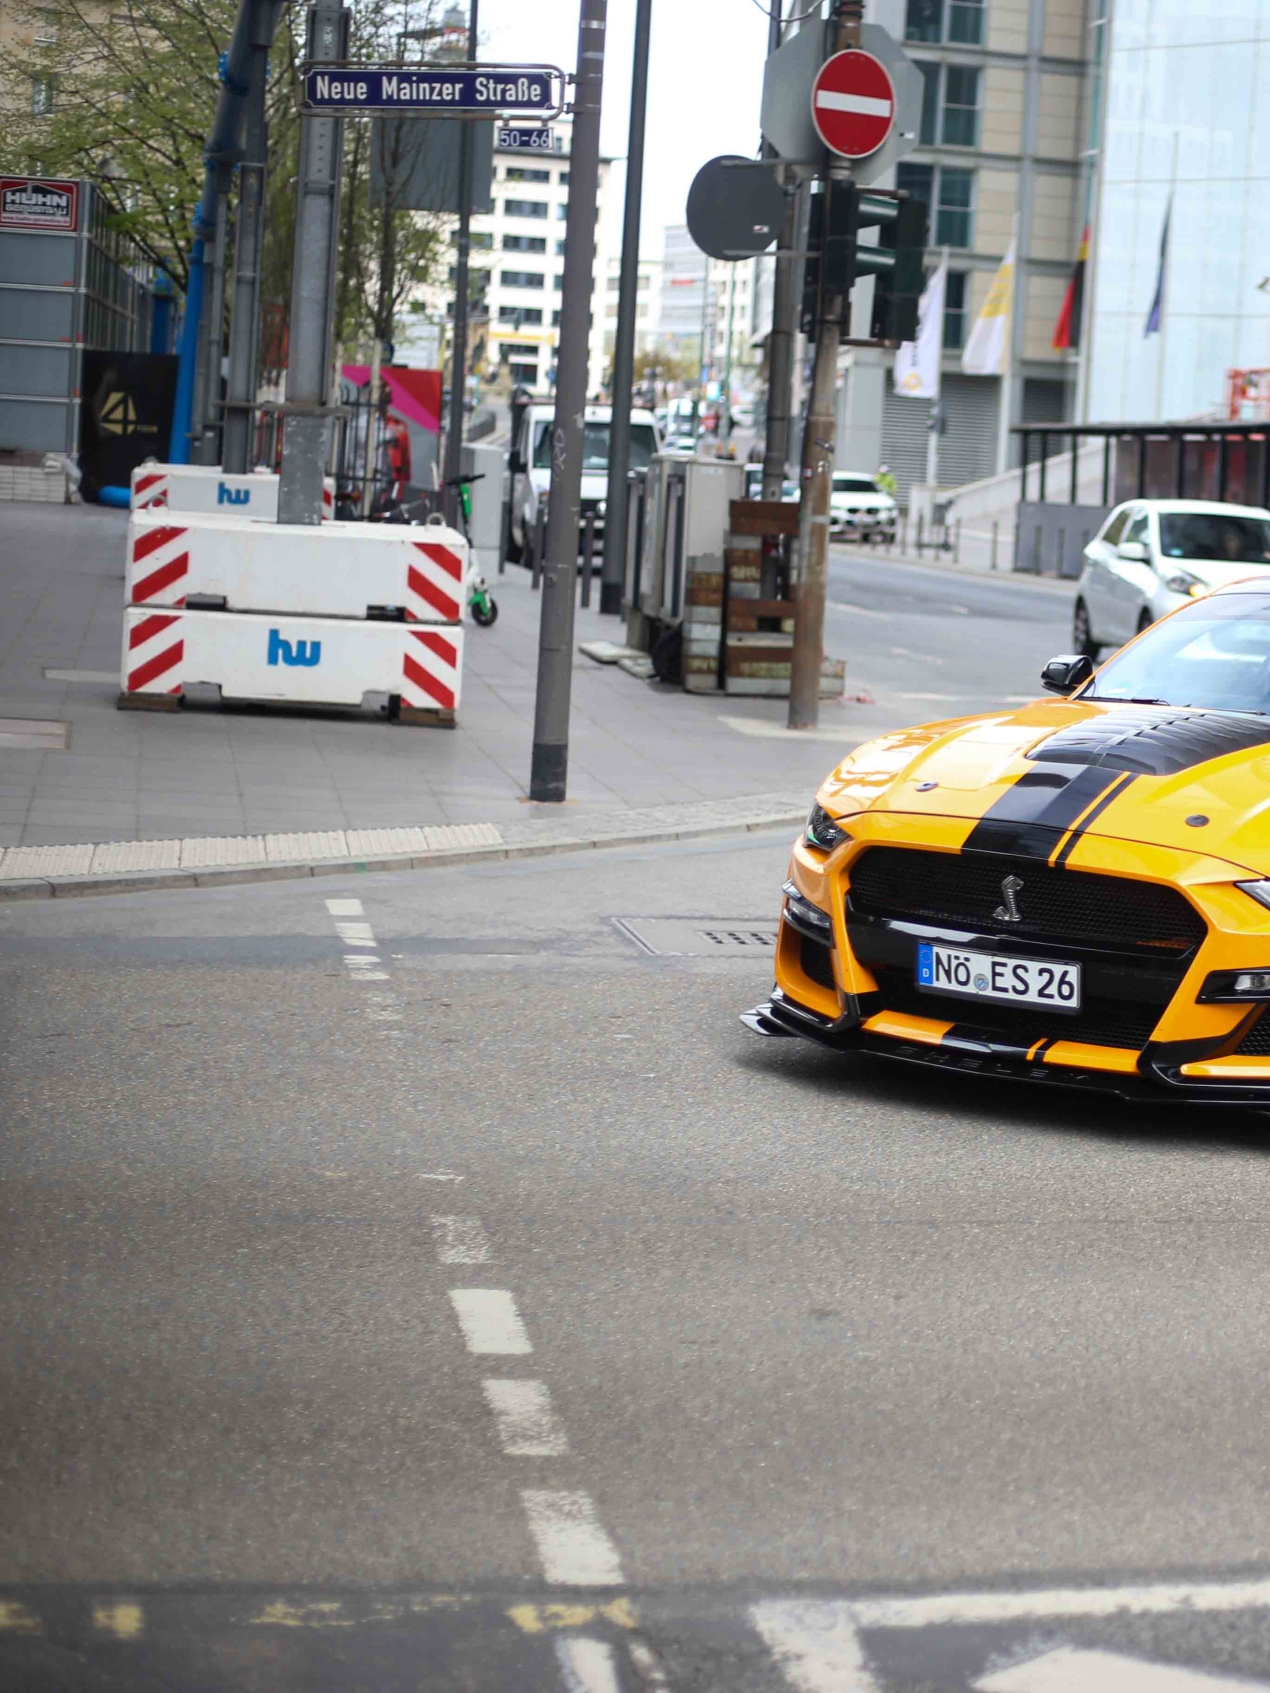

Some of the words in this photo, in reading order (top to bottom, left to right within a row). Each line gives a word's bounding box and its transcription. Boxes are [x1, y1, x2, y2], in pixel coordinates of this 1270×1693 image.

[316, 75, 368, 100] Neue
[382, 76, 464, 101] Mainzer
[475, 77, 542, 102] Straße
[500, 130, 550, 147] 50-66
[218, 482, 251, 505] hw
[267, 628, 322, 667] hw
[922, 968, 930, 978] D
[935, 952, 971, 987] NÖ
